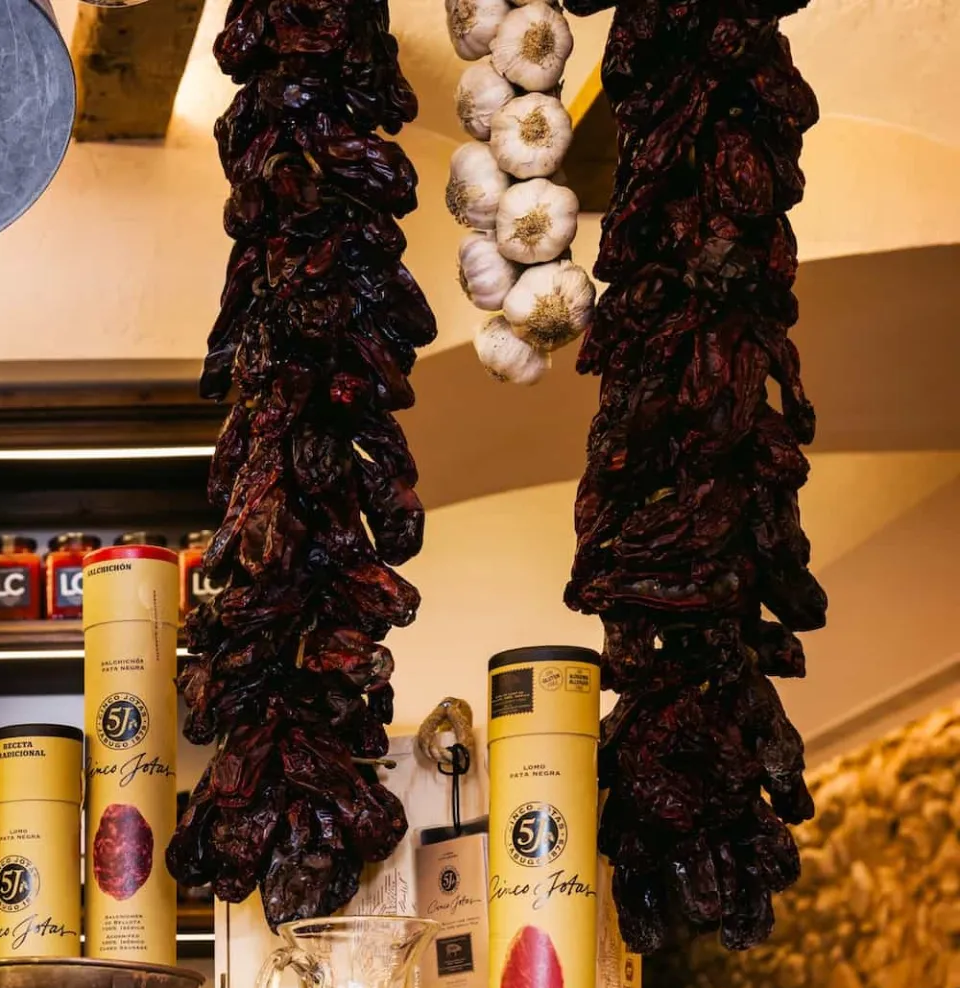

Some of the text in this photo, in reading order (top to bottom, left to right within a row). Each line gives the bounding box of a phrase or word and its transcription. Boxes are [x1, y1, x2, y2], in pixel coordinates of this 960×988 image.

[106, 706, 134, 738] 5J
[119, 752, 176, 788] Jotas
[517, 816, 548, 853] 5J
[0, 869, 25, 900] 5J
[532, 869, 597, 910] Jotas
[12, 913, 76, 950] Jotas
